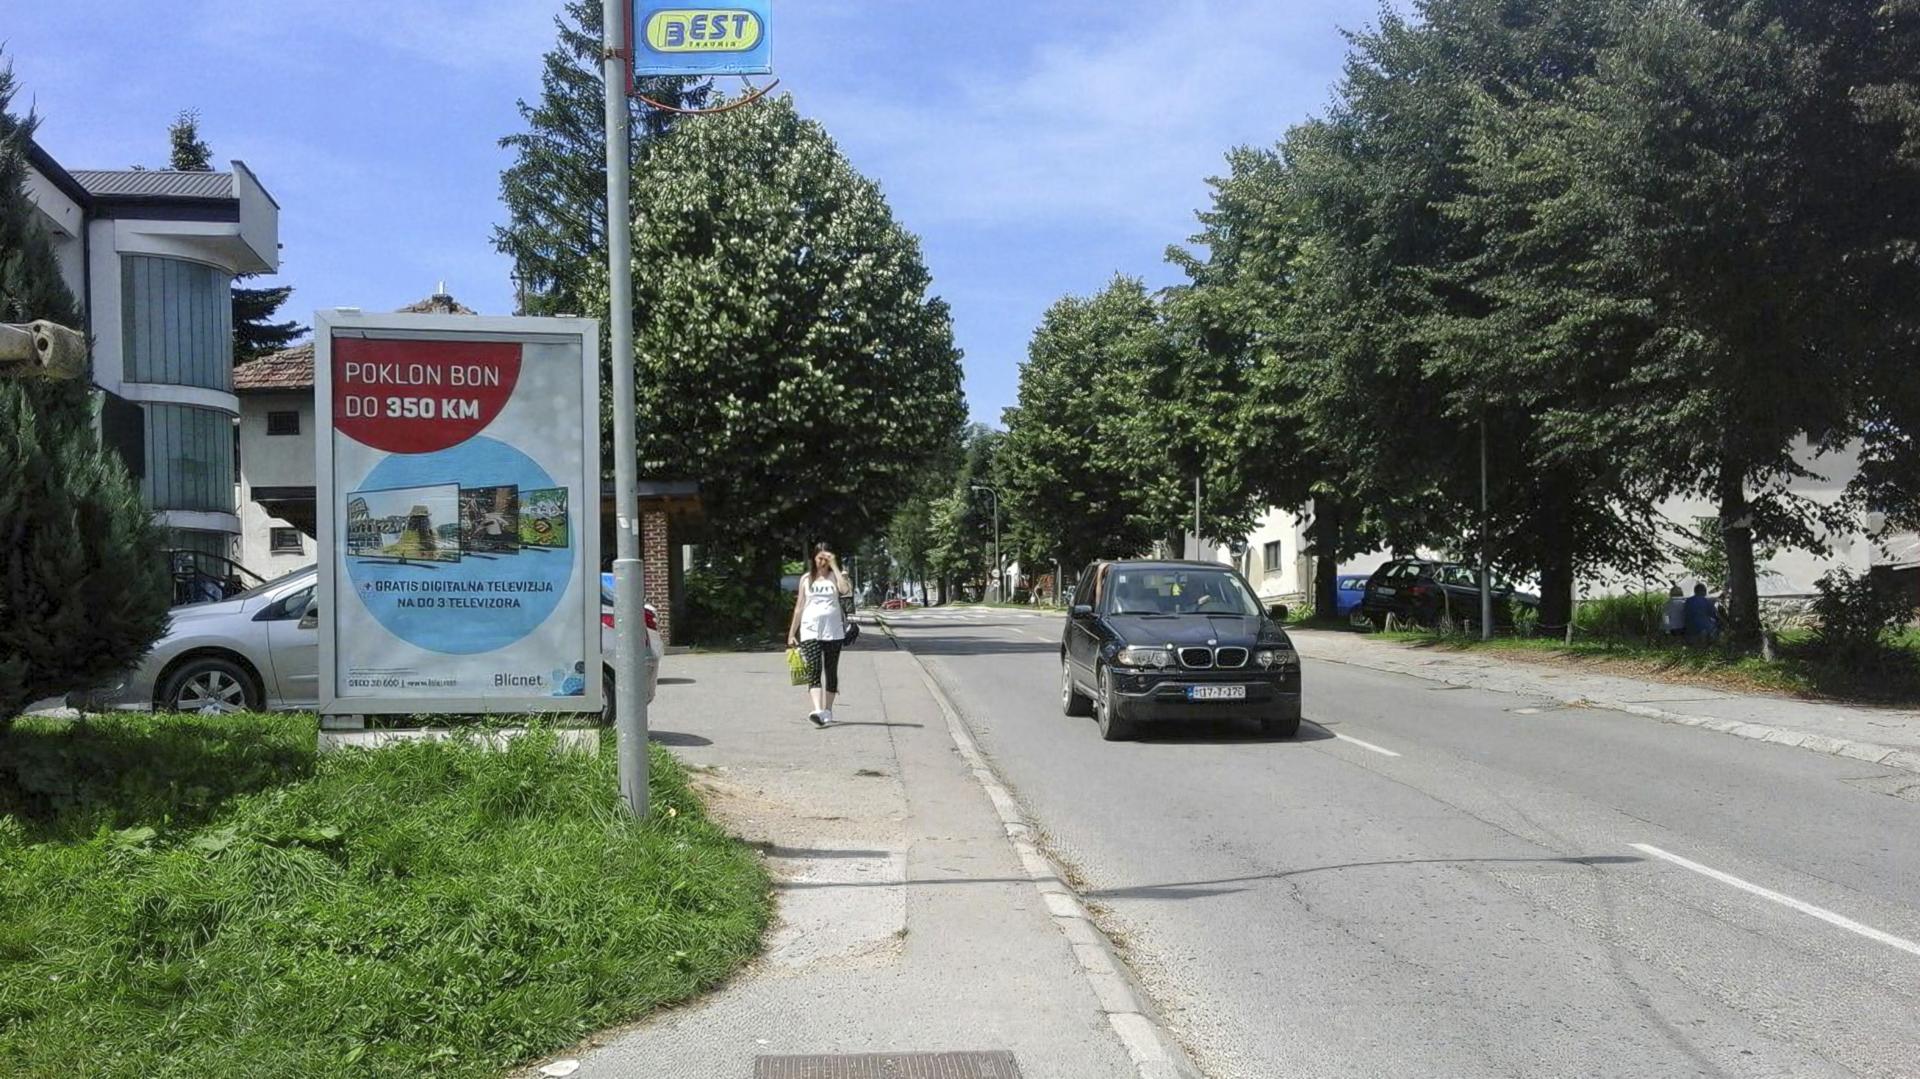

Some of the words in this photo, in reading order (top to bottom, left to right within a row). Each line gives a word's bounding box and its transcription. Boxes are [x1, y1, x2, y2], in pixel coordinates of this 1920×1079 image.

[660, 14, 750, 47] BEST
[345, 362, 441, 385] POKLON
[450, 365, 499, 387] BON
[345, 395, 378, 418] DO
[386, 397, 436, 419] 350
[441, 398, 480, 420] KM
[375, 580, 419, 592] GRATIS
[421, 580, 484, 593] DIGITALNA
[488, 580, 553, 593] TELEVIZIJA
[397, 597, 415, 609] NA
[417, 597, 435, 609] DO
[437, 597, 446, 609] 3
[449, 597, 521, 609] TELEVIZORA
[494, 673, 544, 687] Blicnet
